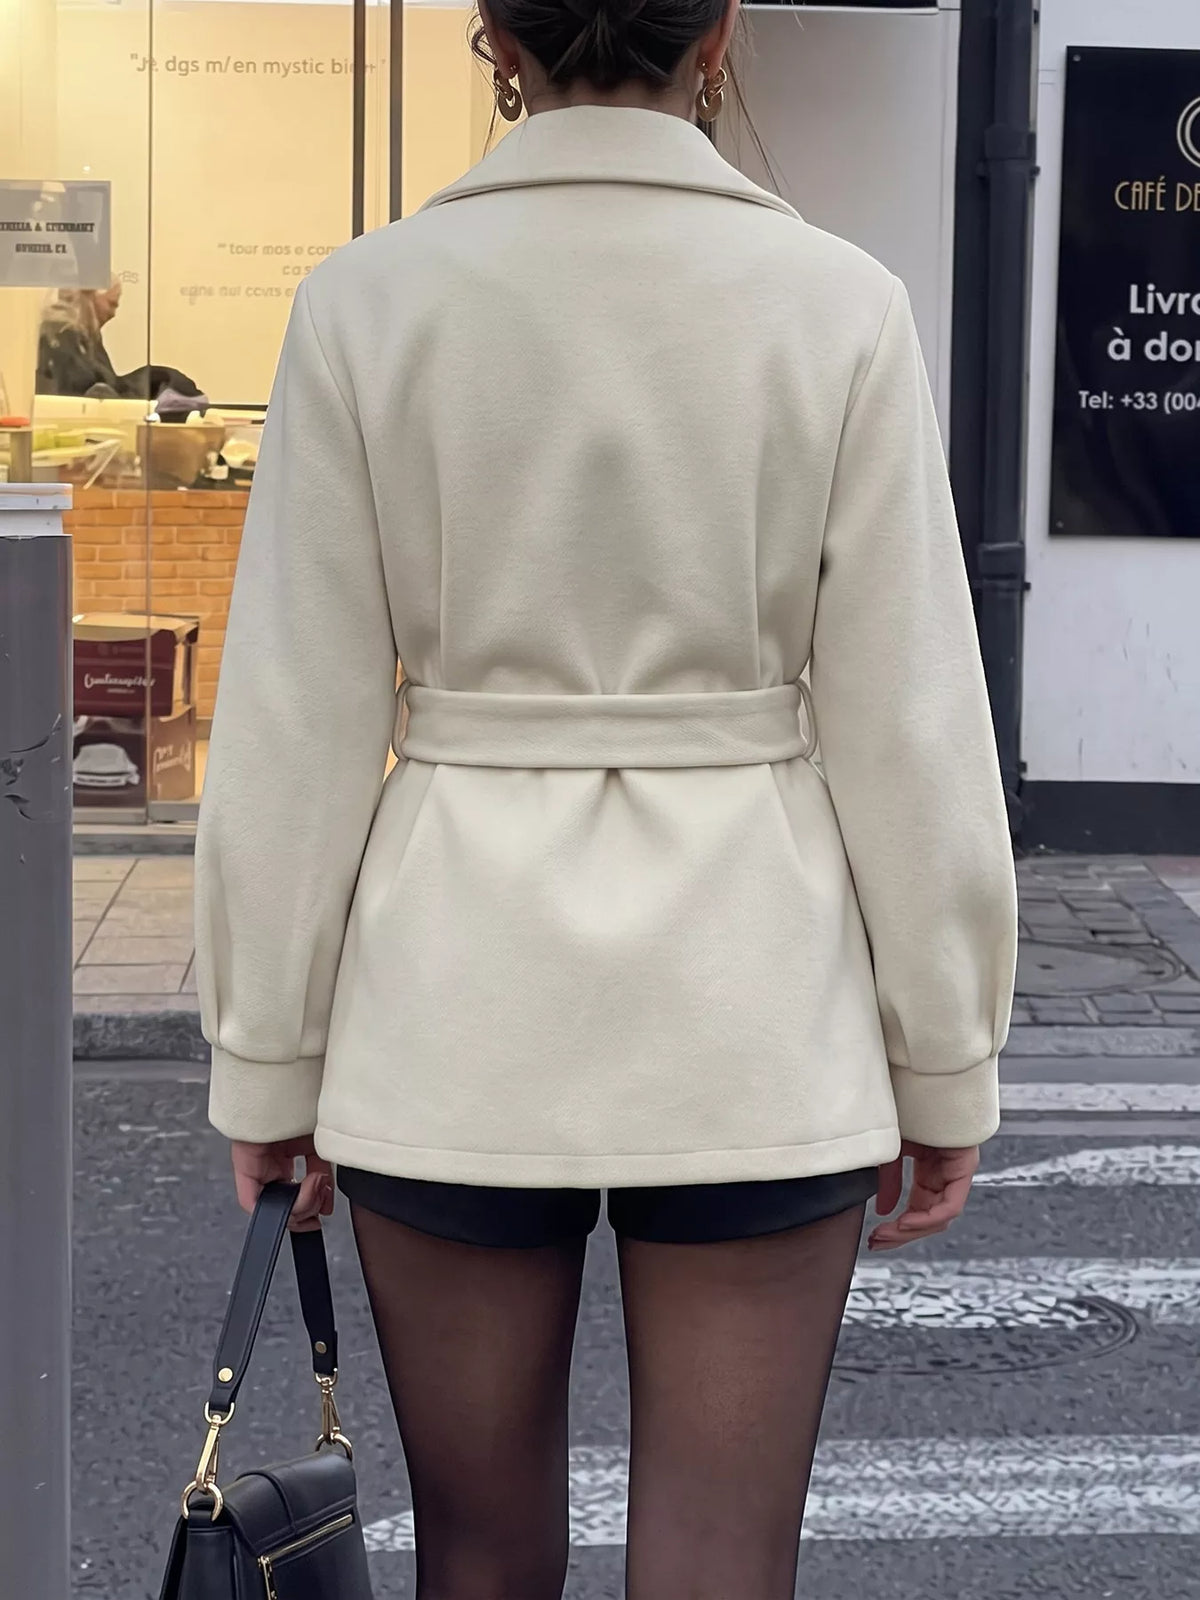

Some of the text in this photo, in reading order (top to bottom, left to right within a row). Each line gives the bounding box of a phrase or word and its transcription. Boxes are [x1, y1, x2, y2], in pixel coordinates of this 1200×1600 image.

[263, 58, 323, 78] mystic
[1115, 175, 1167, 211] CAFÉ
[1107, 327, 1200, 362] à do
[1078, 390, 1200, 415] Tel: +33 (00
